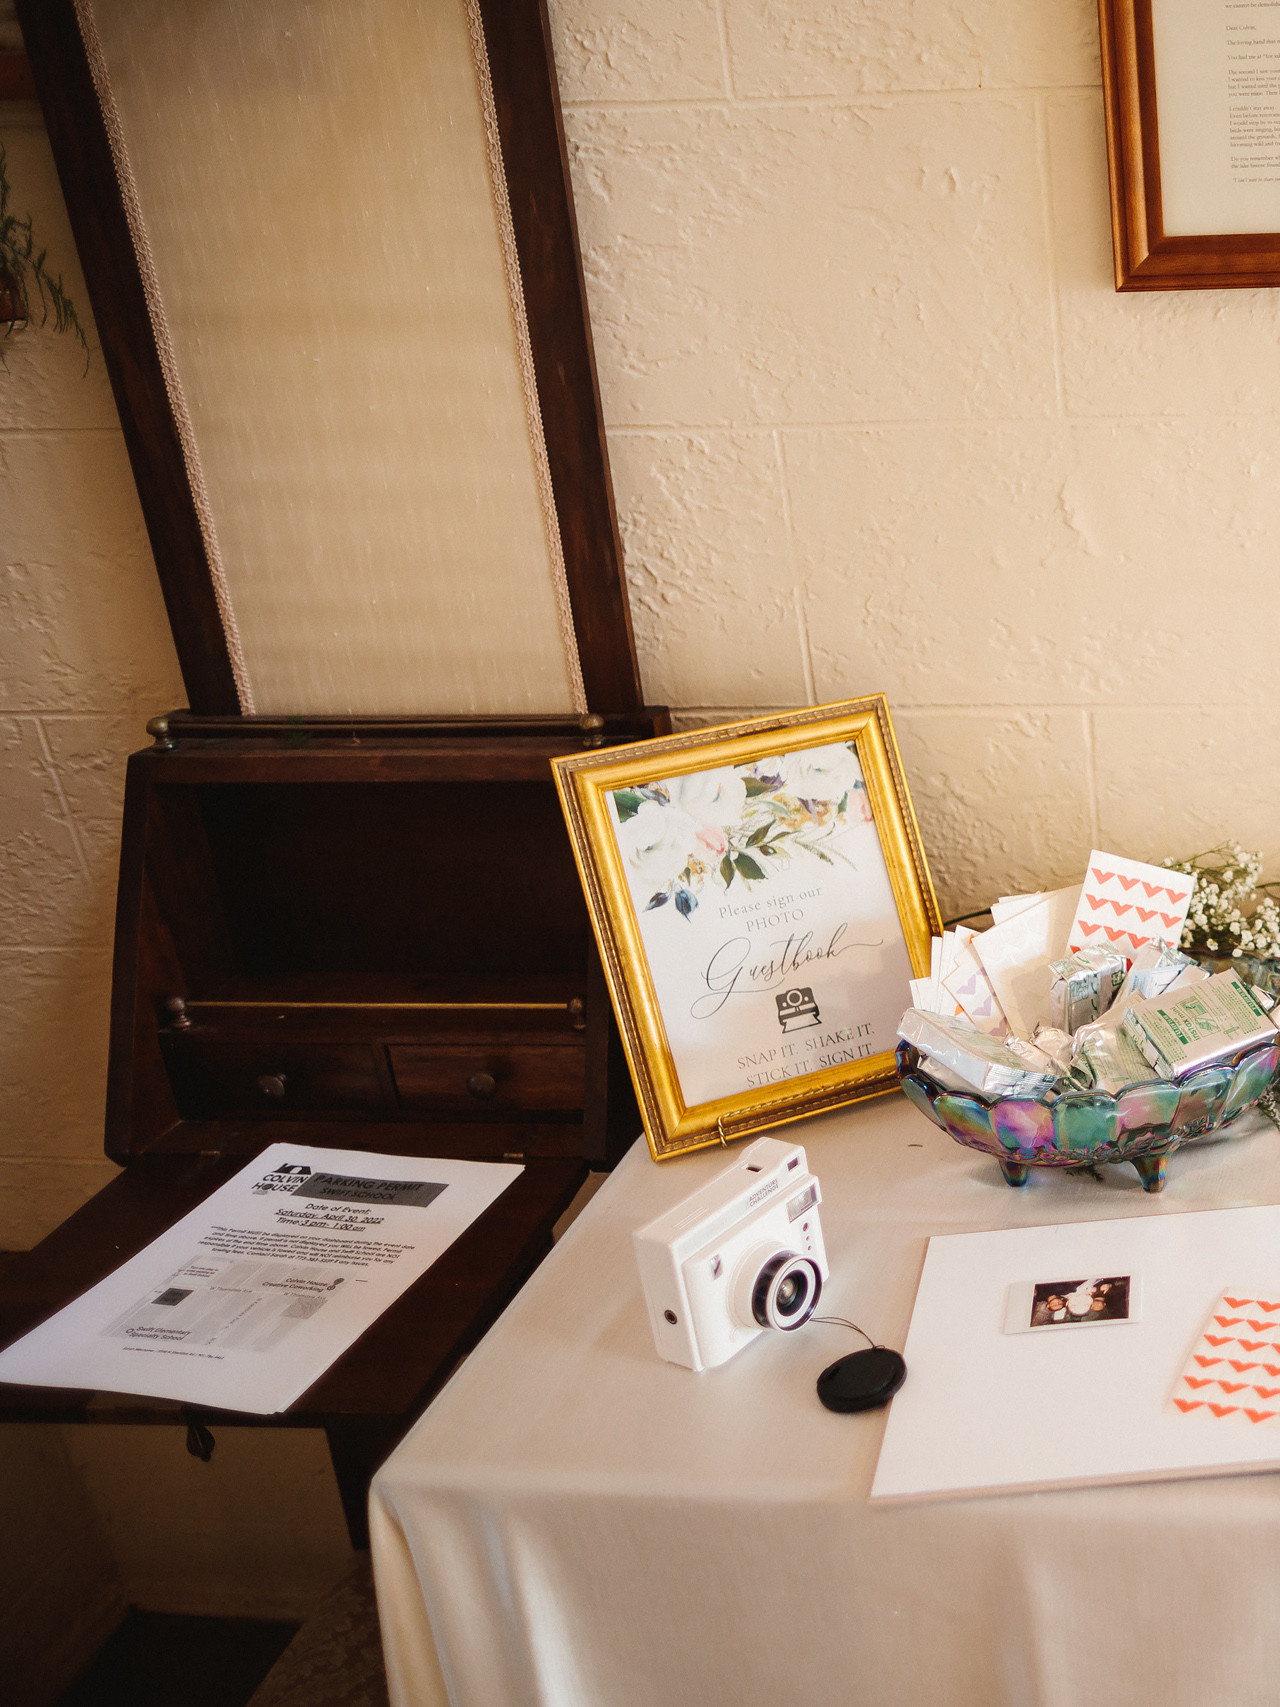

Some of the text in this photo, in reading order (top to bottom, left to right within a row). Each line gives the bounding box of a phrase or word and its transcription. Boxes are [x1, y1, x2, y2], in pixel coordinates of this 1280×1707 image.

[718, 887, 823, 919] Please sign our
[746, 908, 804, 932] PHOTO
[690, 922, 884, 1020] Guestbook
[737, 1022, 875, 1070] SNAP IT. SHAKE IT.
[746, 1042, 876, 1087] STICK IT. SIGN IT.
[262, 1174, 309, 1184] COLVIN
[313, 1174, 425, 1191] PARKING PERMIT
[251, 1182, 300, 1192] HOUSE
[320, 1187, 396, 1200] SWIFT SCHOOL
[305, 1203, 372, 1215] Date of Event:
[321, 1211, 346, 1221] April
[360, 1216, 385, 1224] 2022
[288, 1283, 324, 1292] Coworking
[154, 1327, 192, 1335] Elementary
